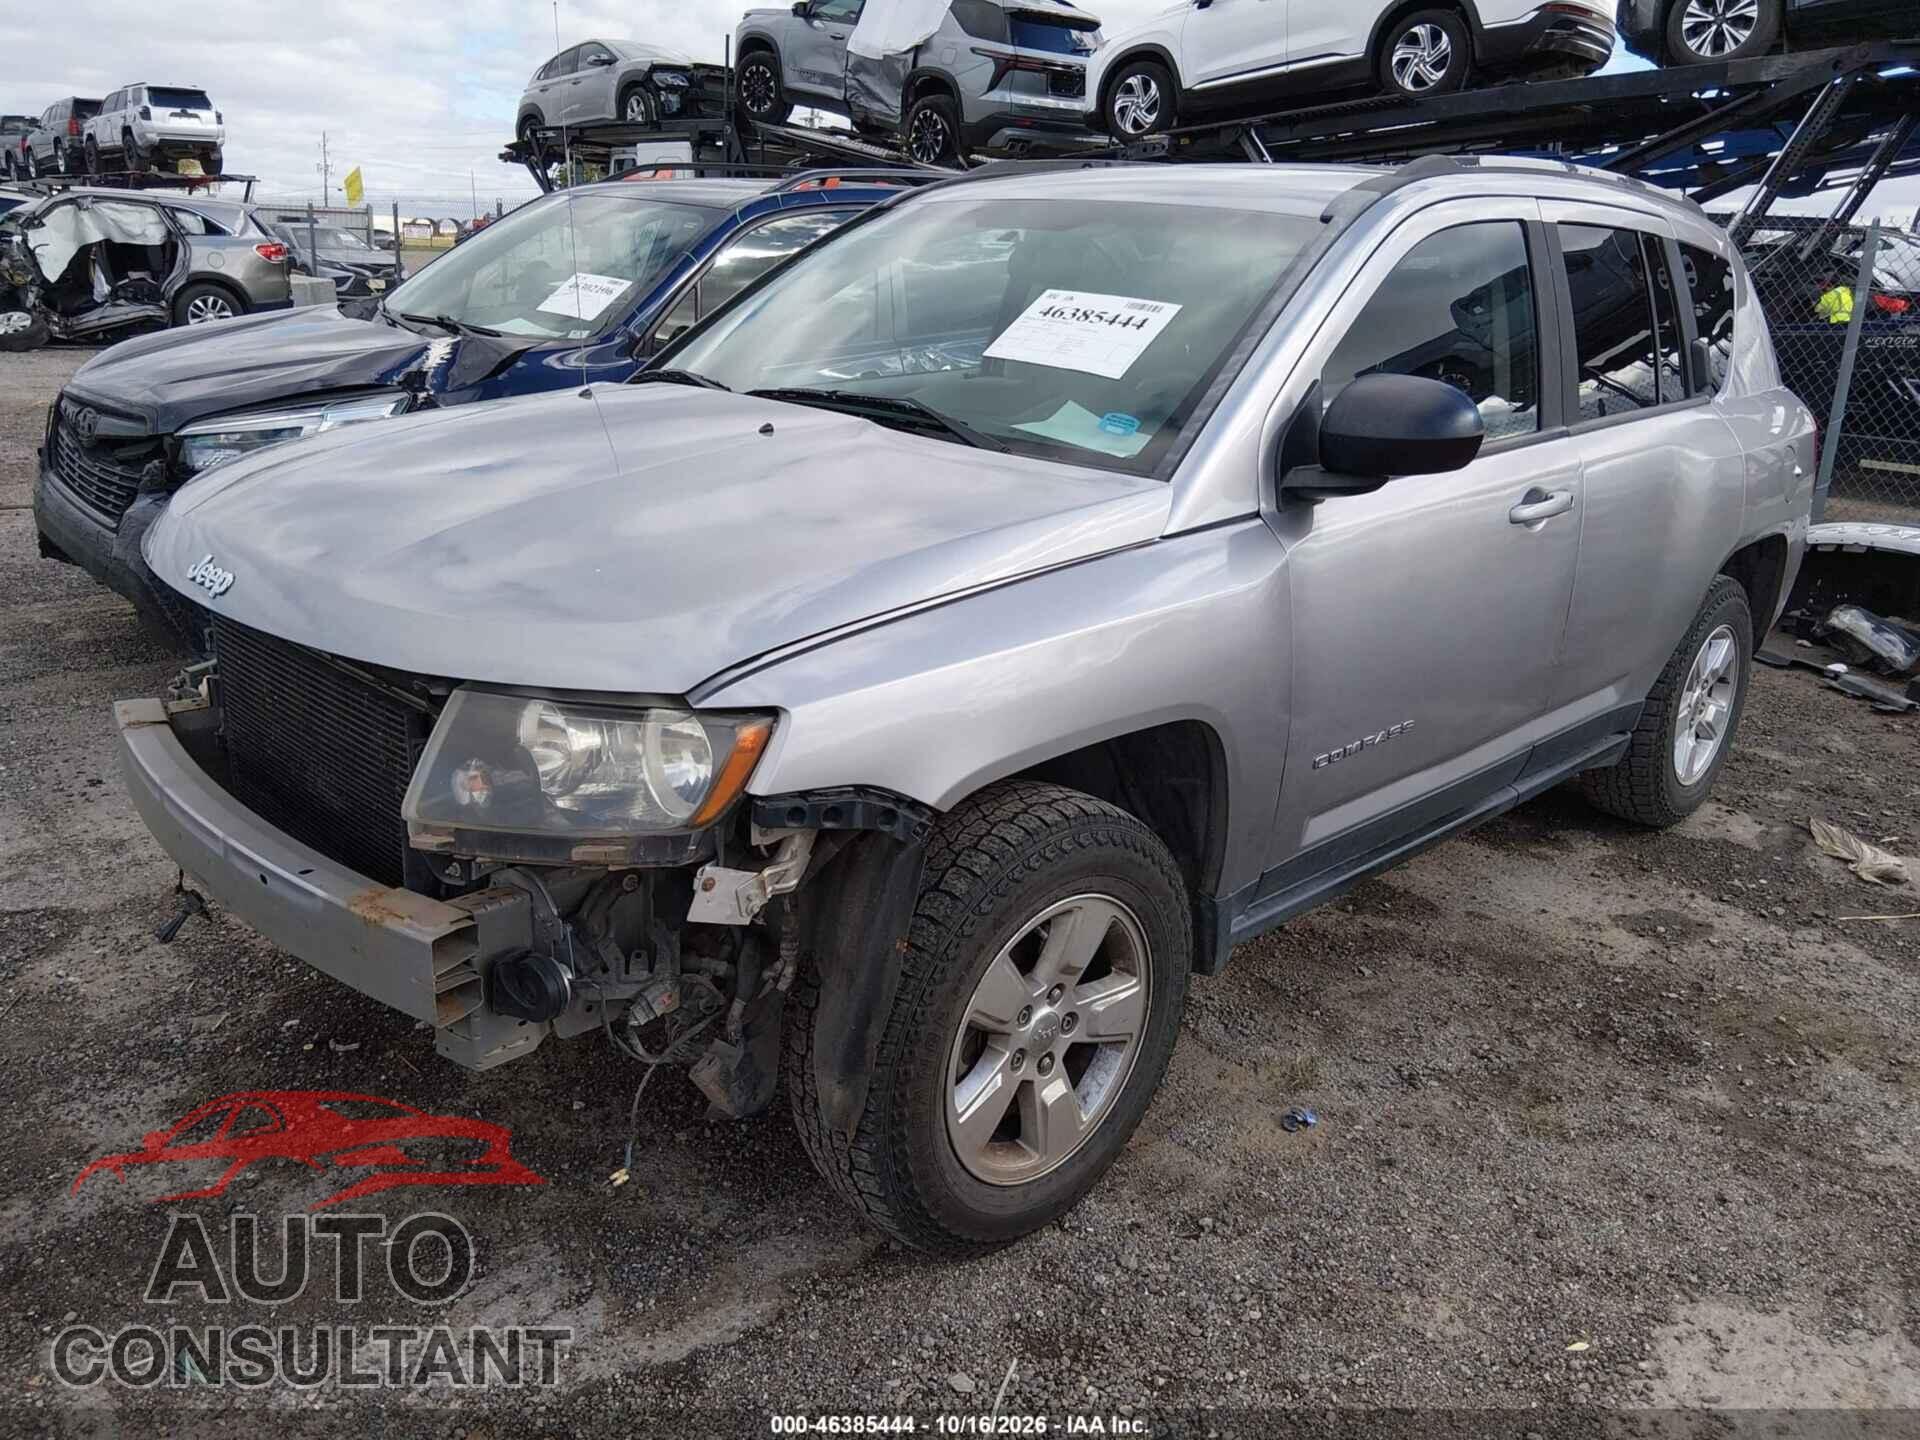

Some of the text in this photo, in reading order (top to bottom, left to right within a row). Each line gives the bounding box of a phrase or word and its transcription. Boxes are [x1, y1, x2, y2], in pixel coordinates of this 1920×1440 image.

[1038, 304, 1150, 331] 46385444
[187, 553, 235, 599] Jeep
[1312, 719, 1415, 770] COMPASS
